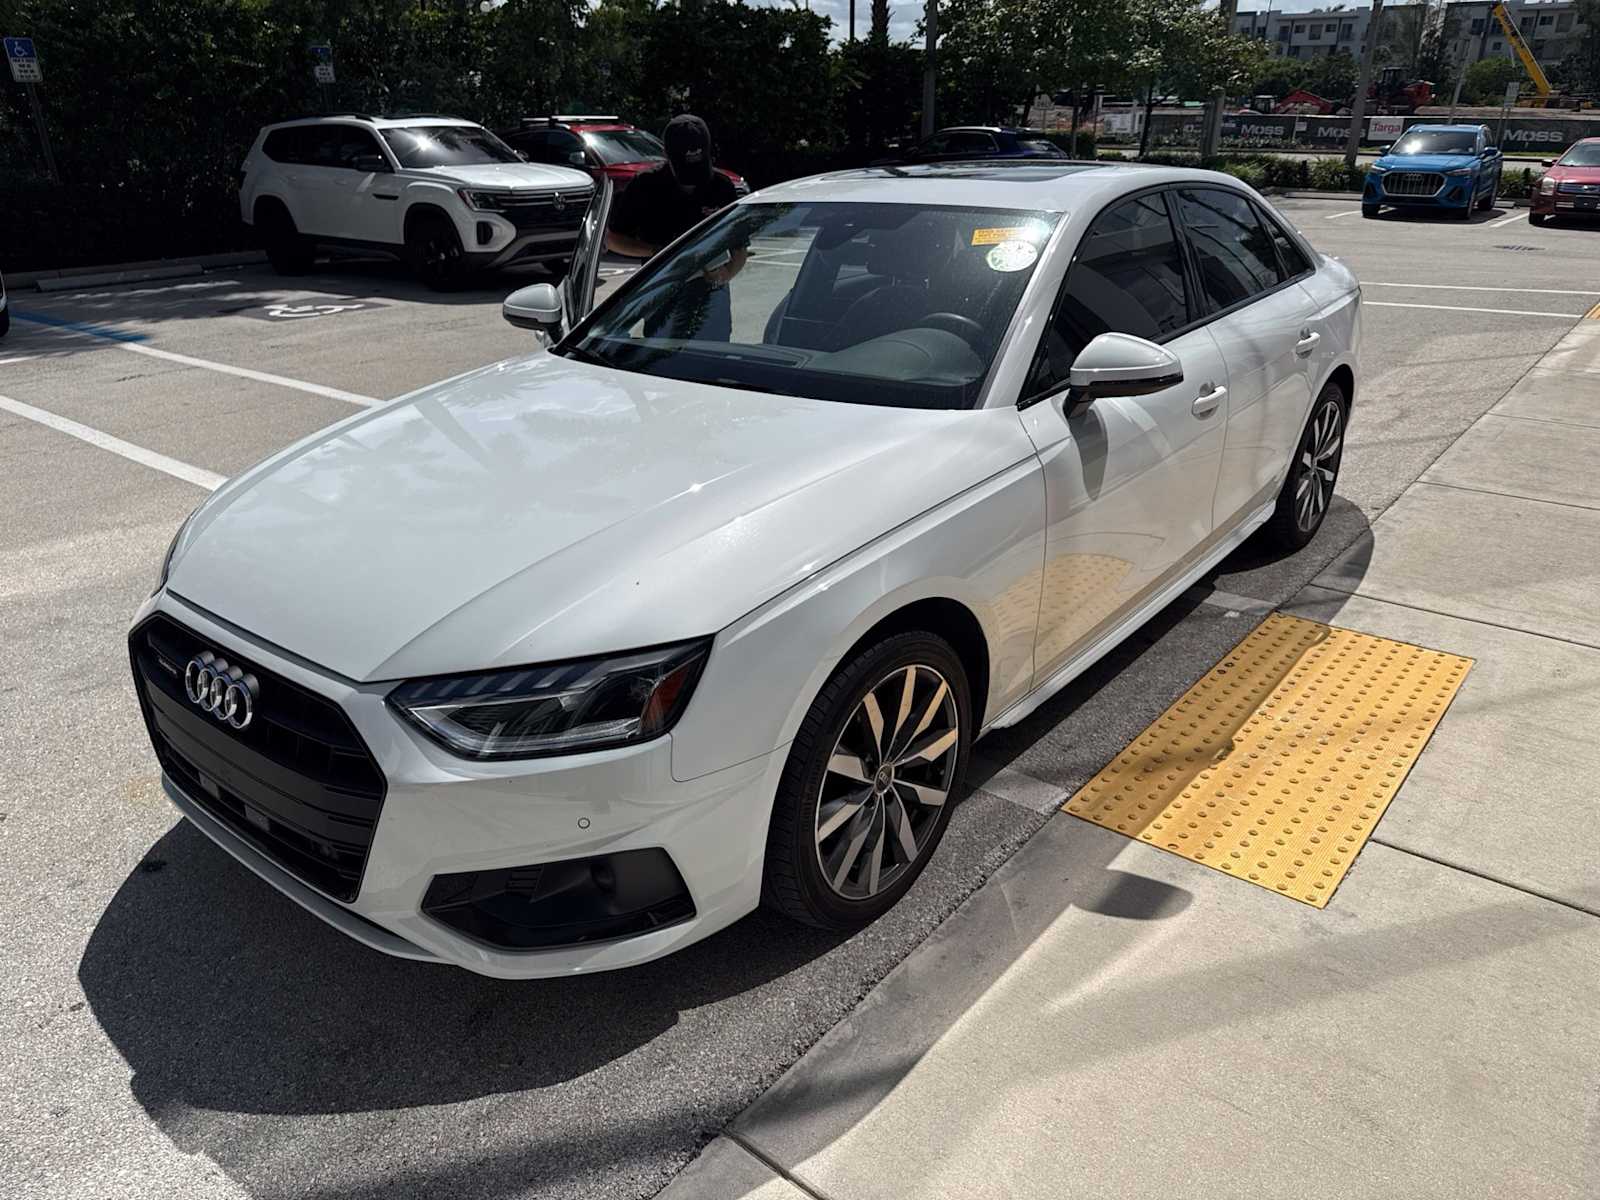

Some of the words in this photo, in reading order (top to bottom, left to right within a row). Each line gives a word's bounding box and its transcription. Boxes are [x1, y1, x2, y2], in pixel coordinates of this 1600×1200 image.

[1241, 124, 1284, 136] MOSS
[1372, 123, 1401, 135] Targa
[1503, 129, 1563, 142] MOSS
